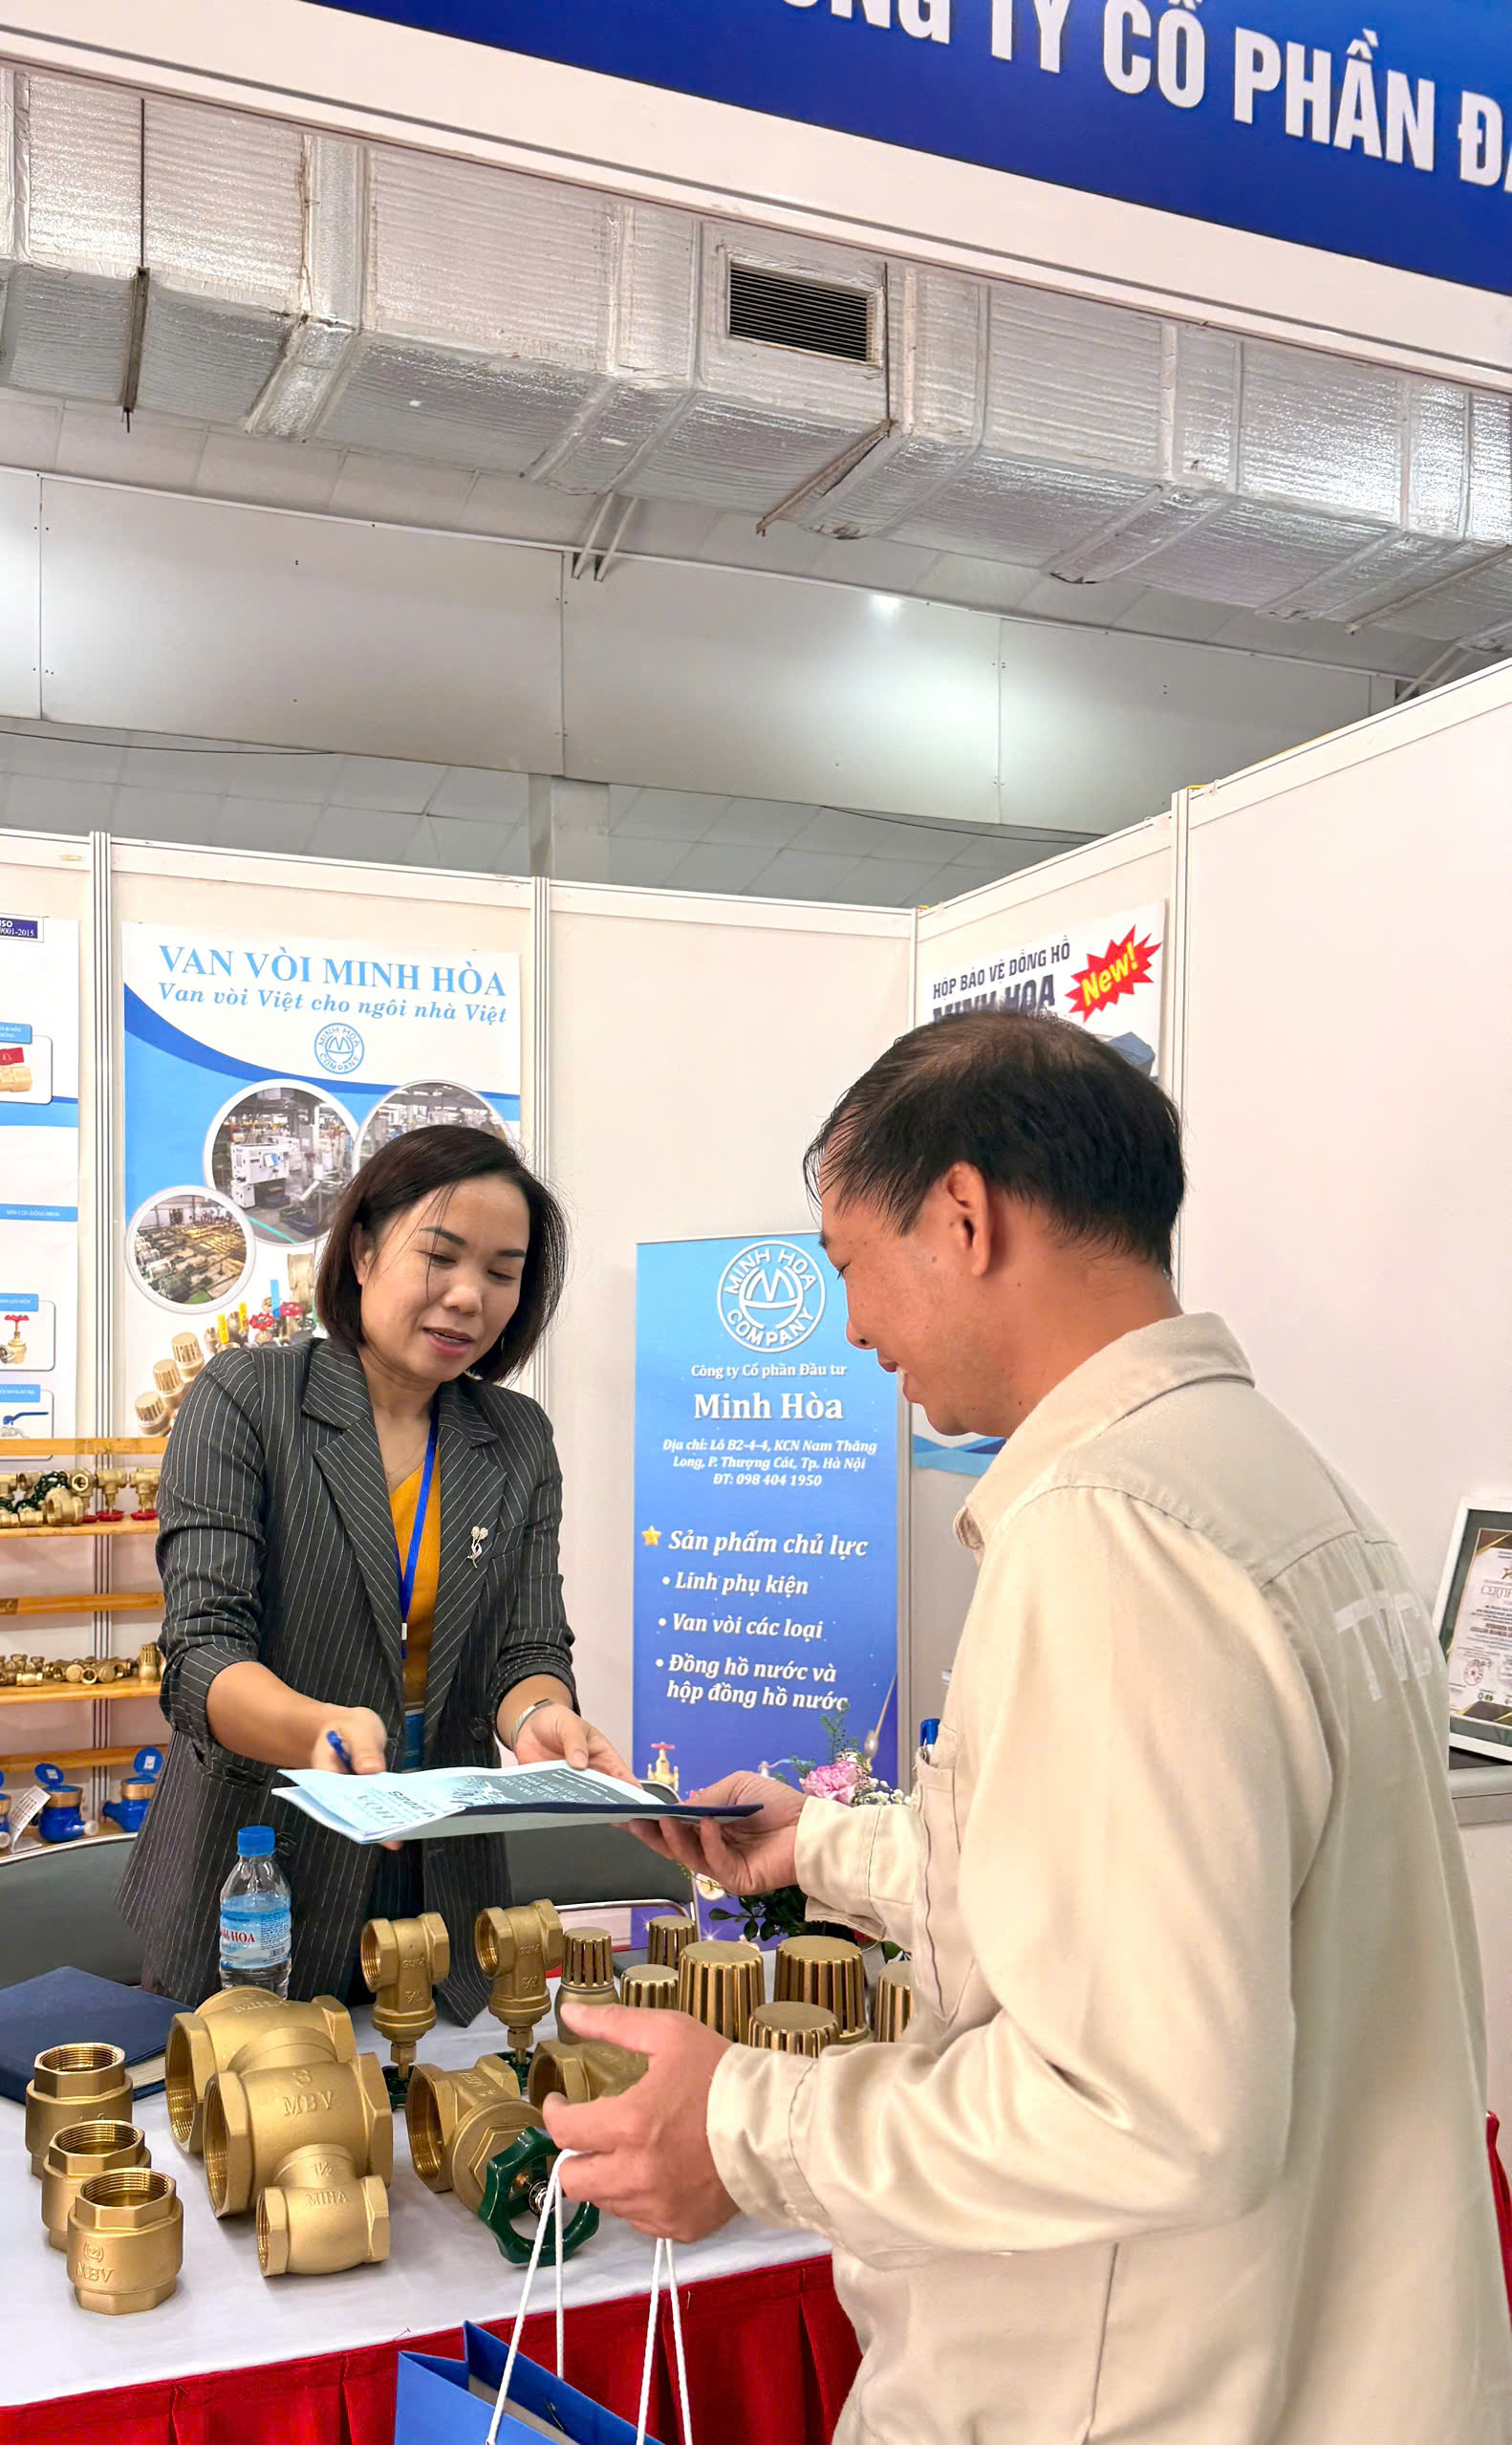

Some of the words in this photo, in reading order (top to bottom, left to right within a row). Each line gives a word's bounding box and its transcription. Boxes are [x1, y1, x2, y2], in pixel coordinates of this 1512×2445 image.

[1233, 28, 1436, 172] PHẦN
[1457, 90, 1512, 192] Đ
[159, 944, 234, 977] VAN
[244, 946, 313, 983] VÒI
[321, 957, 421, 990] MINH
[431, 961, 507, 996] HÒA
[1081, 941, 1139, 1007] New!
[158, 982, 205, 1003] Van
[213, 987, 249, 1006] vòi
[257, 988, 304, 1012] Việt
[311, 994, 351, 1013] cho
[357, 999, 407, 1019] ngôi
[414, 1002, 457, 1020] nhà
[464, 1004, 508, 1026] Việt
[724, 1248, 771, 1296] MINH
[778, 1248, 817, 1292] HOA
[726, 1307, 815, 1347] COMPANY
[691, 1364, 724, 1379] Công
[726, 1366, 740, 1379] ty
[761, 1363, 796, 1378] phần
[800, 1362, 827, 1376] Đầu
[831, 1364, 848, 1376] tư
[694, 1392, 772, 1419] Minh
[780, 1391, 843, 1419] Hòa
[662, 1439, 683, 1453] Địa
[726, 1439, 771, 1453] B2-4-4,
[773, 1439, 801, 1452] KCN
[802, 1439, 832, 1452] Nam
[673, 1456, 705, 1469] Long,
[708, 1456, 718, 1468] P.
[721, 1456, 770, 1471] Thượng
[773, 1456, 797, 1469] Cát,
[801, 1457, 819, 1471] Tp.
[822, 1457, 841, 1469] Hà
[843, 1457, 867, 1472] Nội
[713, 1473, 733, 1484] ĐT:
[736, 1473, 760, 1485] 098
[763, 1474, 787, 1485] 404
[790, 1474, 822, 1486] 1950
[668, 1529, 708, 1550] Sản
[713, 1530, 777, 1556] phẩm
[783, 1533, 824, 1555] chủ
[829, 1534, 869, 1561] lực
[674, 1571, 718, 1590] Linh
[721, 1574, 761, 1596] phụ
[766, 1575, 810, 1598] kiện
[672, 1612, 707, 1632] Van
[713, 1614, 743, 1634] vòi
[745, 1617, 780, 1636] các
[784, 1619, 824, 1643] loại
[667, 1653, 719, 1679] Đồng
[724, 1655, 749, 1677] hồ
[753, 1659, 808, 1681] nước
[812, 1663, 837, 1682] và
[666, 1679, 703, 1704] hộp
[707, 1682, 758, 1709] đồng
[762, 1686, 788, 1706] hồ
[791, 1690, 849, 1712] nước
[282, 2089, 334, 2116] MBV
